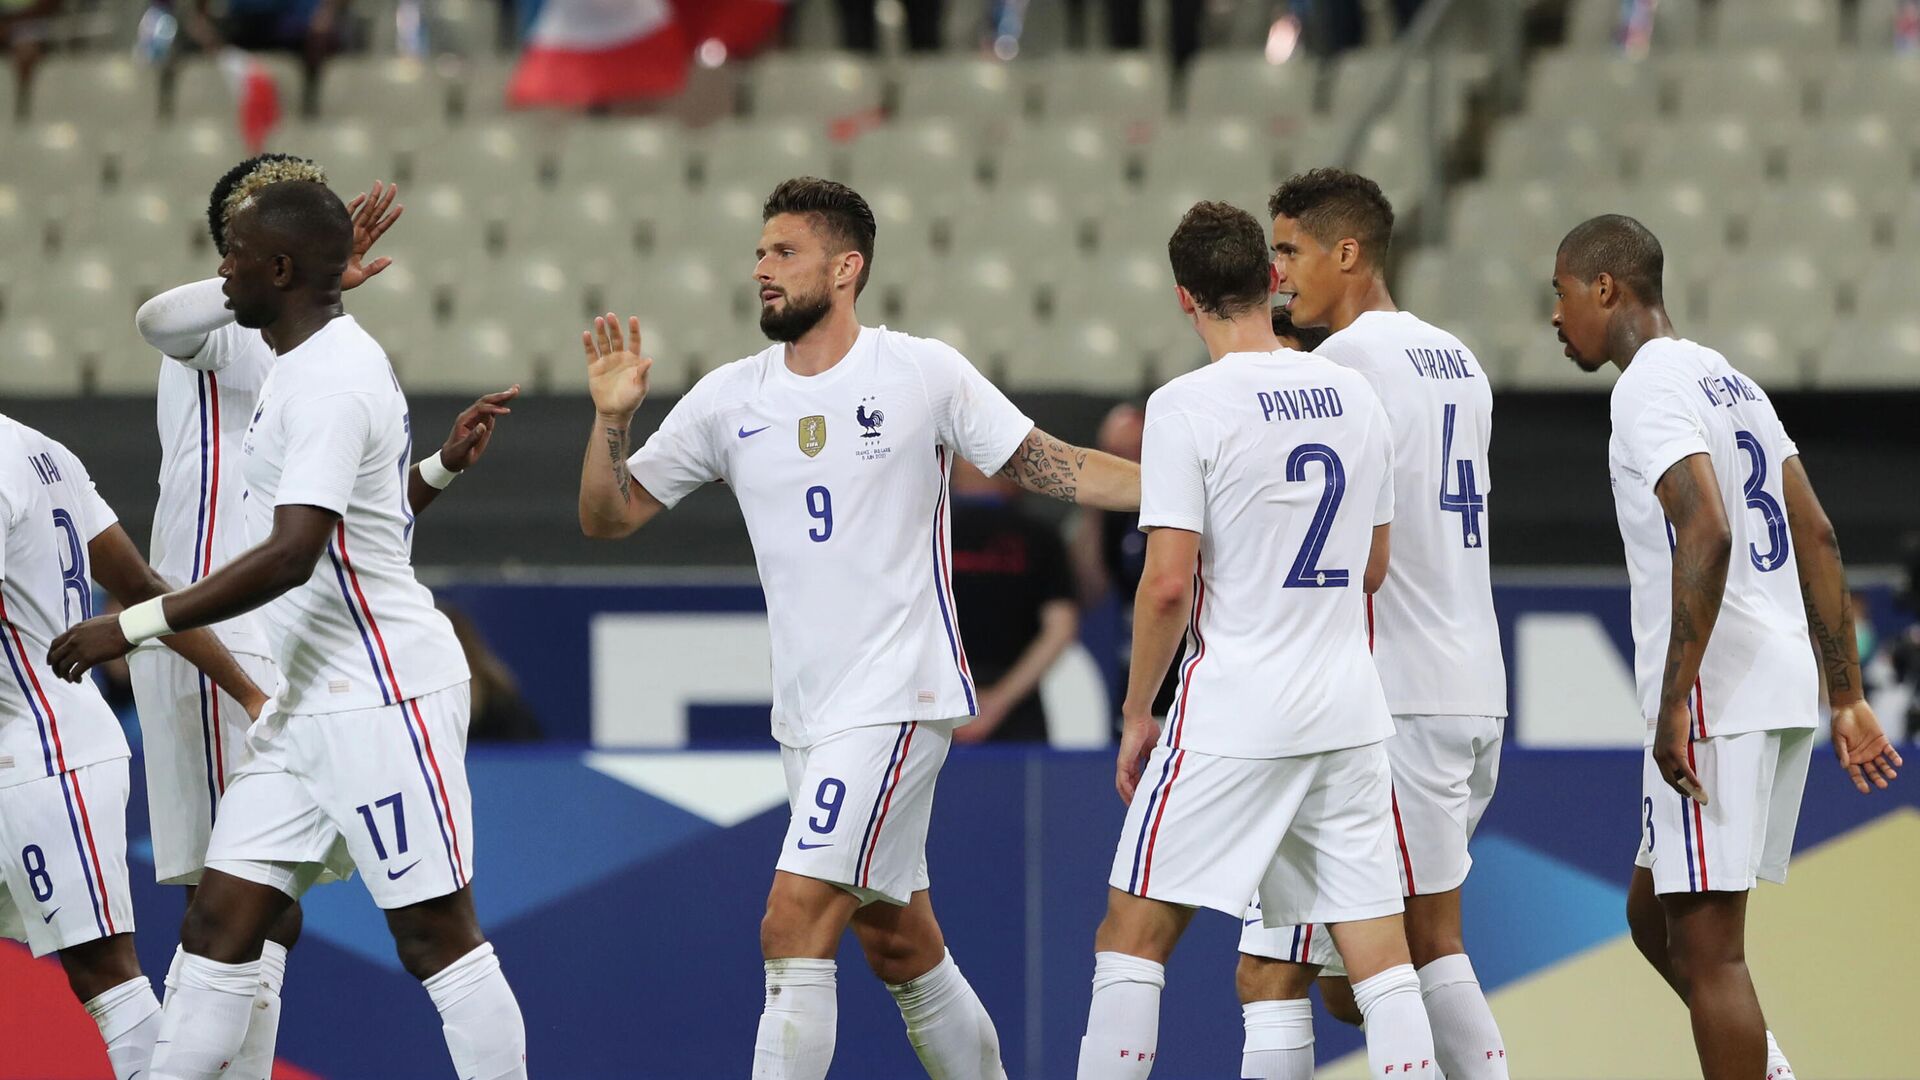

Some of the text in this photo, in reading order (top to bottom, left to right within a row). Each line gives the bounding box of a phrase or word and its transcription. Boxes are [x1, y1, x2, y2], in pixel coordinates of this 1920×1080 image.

[1405, 348, 1475, 380] VARANE
[1257, 387, 1343, 421] PAVARD
[1440, 403, 1484, 548] 4
[1735, 430, 1789, 573] 3
[806, 485, 833, 542] 9
[1282, 443, 1349, 588] 2
[356, 792, 408, 861] 17
[809, 777, 846, 834] 9
[1644, 796, 1655, 853] 3
[22, 844, 53, 902] 8
